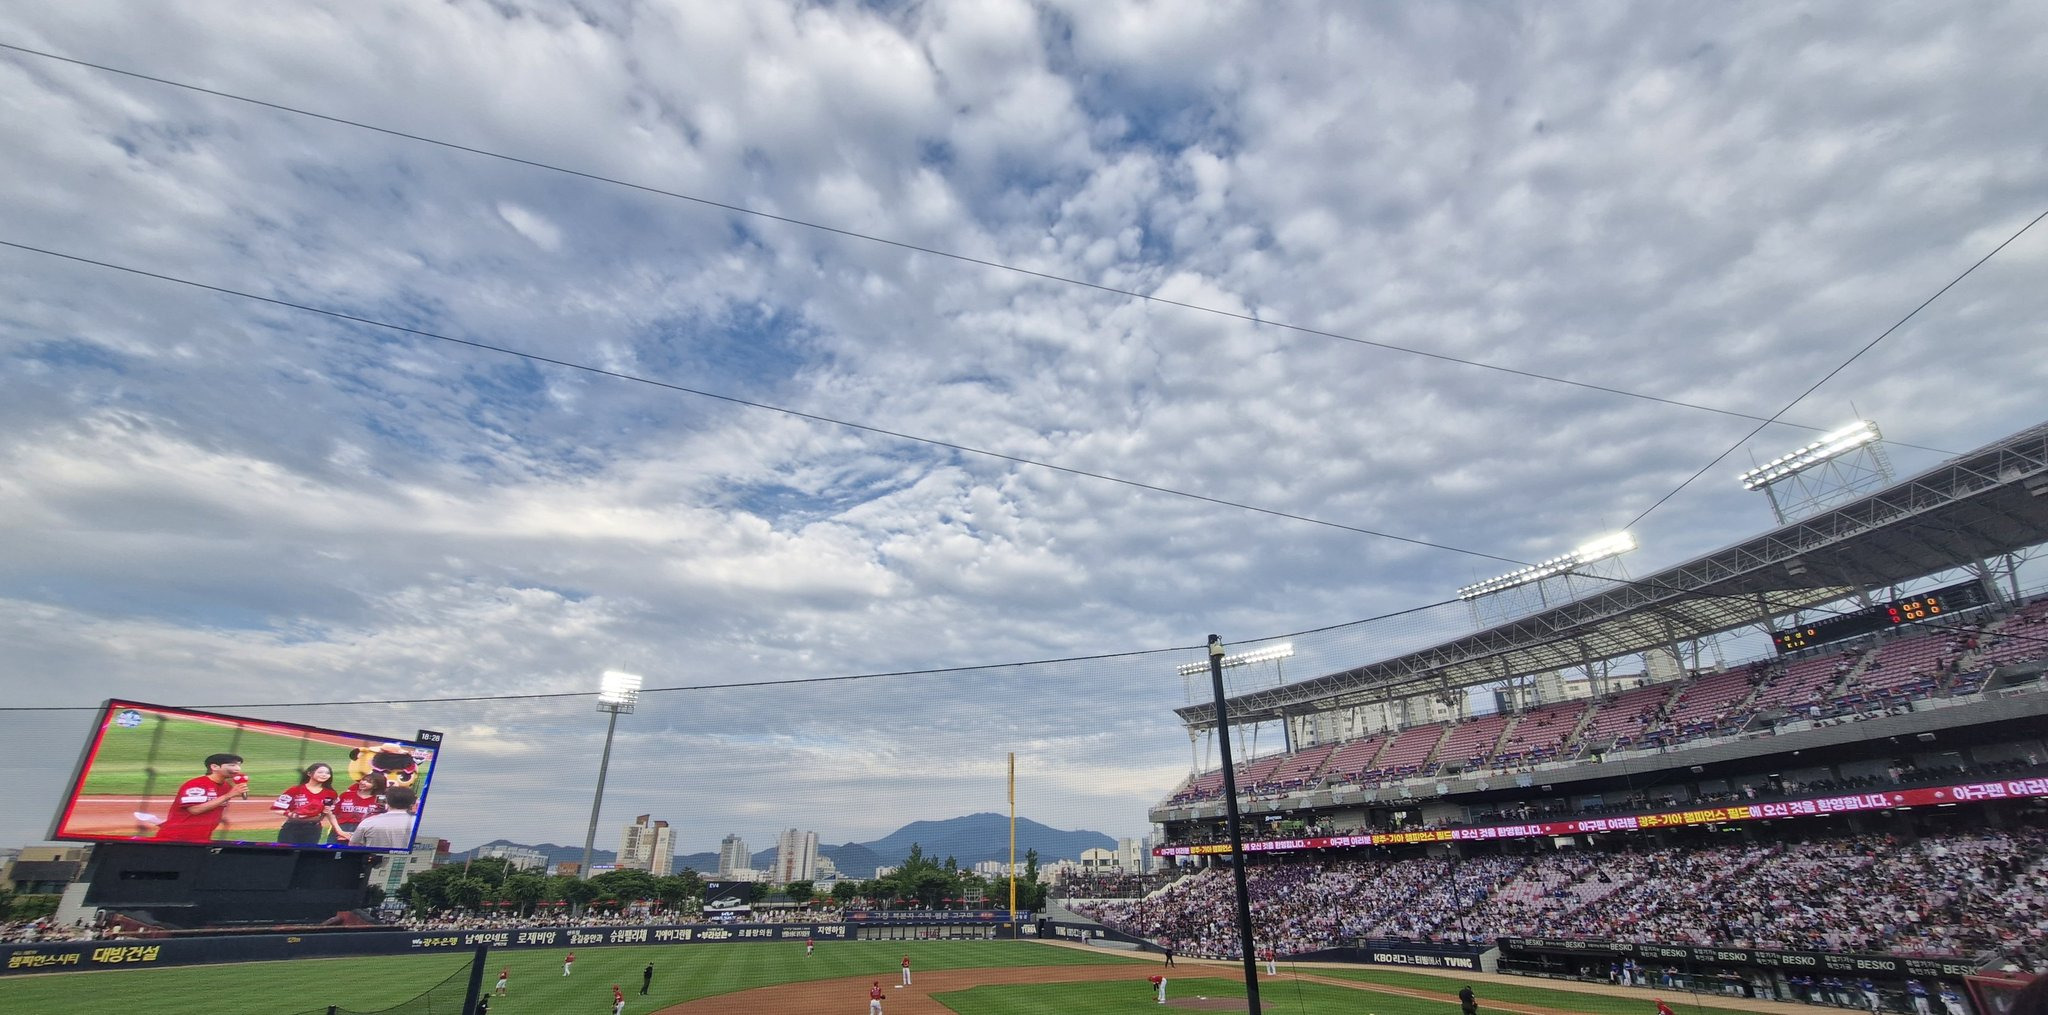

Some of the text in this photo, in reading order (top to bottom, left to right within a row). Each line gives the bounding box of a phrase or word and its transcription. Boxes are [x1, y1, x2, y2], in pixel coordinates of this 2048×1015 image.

[1952, 778, 2048, 800] 야구팬 여러
[1578, 794, 1891, 831] 야구팬 여러분 광주-기아 챔피언스 필드에 오신 것을 환영합니다.
[1330, 825, 1544, 846] 야구팬 여러분 광주-기아 챔피언스 필드에 오신 것을 환영합니다.
[423, 937, 458, 947] 광주은행
[517, 932, 556, 944] 로제비앙
[92, 946, 160, 963] 대방건설
[1661, 949, 1687, 958] BESKO
[1718, 952, 1747, 961] BESKO
[8, 953, 80, 969] 챔피언스시티
[1374, 953, 1472, 968] KBO 리그는 티빙에서 TVING
[1782, 955, 1816, 966] BESKO
[1857, 960, 1895, 970] BESKO
[1943, 965, 1978, 975] BESK
